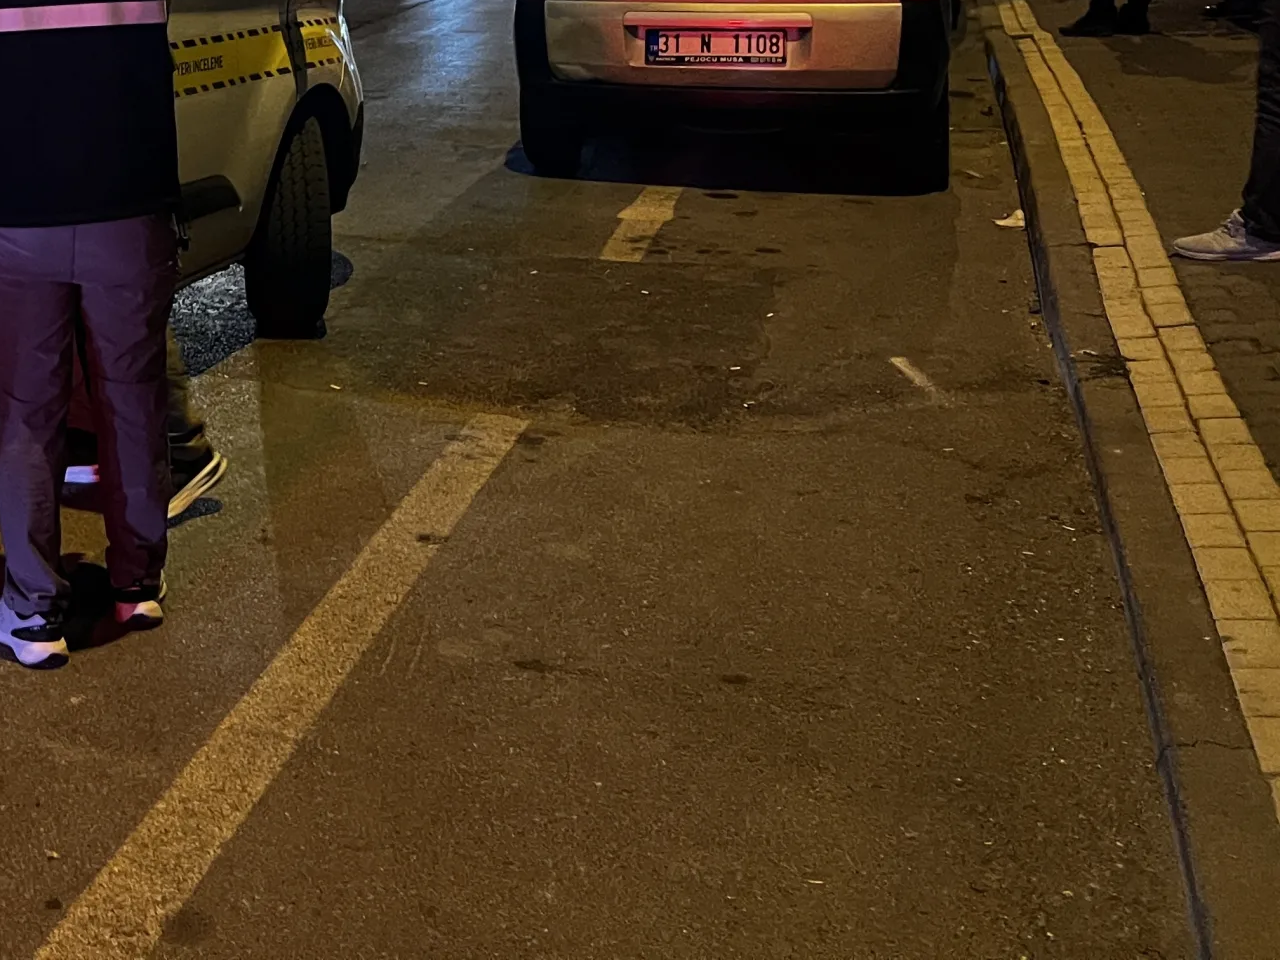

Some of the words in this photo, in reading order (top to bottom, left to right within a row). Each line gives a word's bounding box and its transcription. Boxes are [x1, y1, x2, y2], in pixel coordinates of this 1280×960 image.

[659, 33, 680, 54] 31
[700, 33, 712, 54] N
[732, 33, 780, 54] 1108
